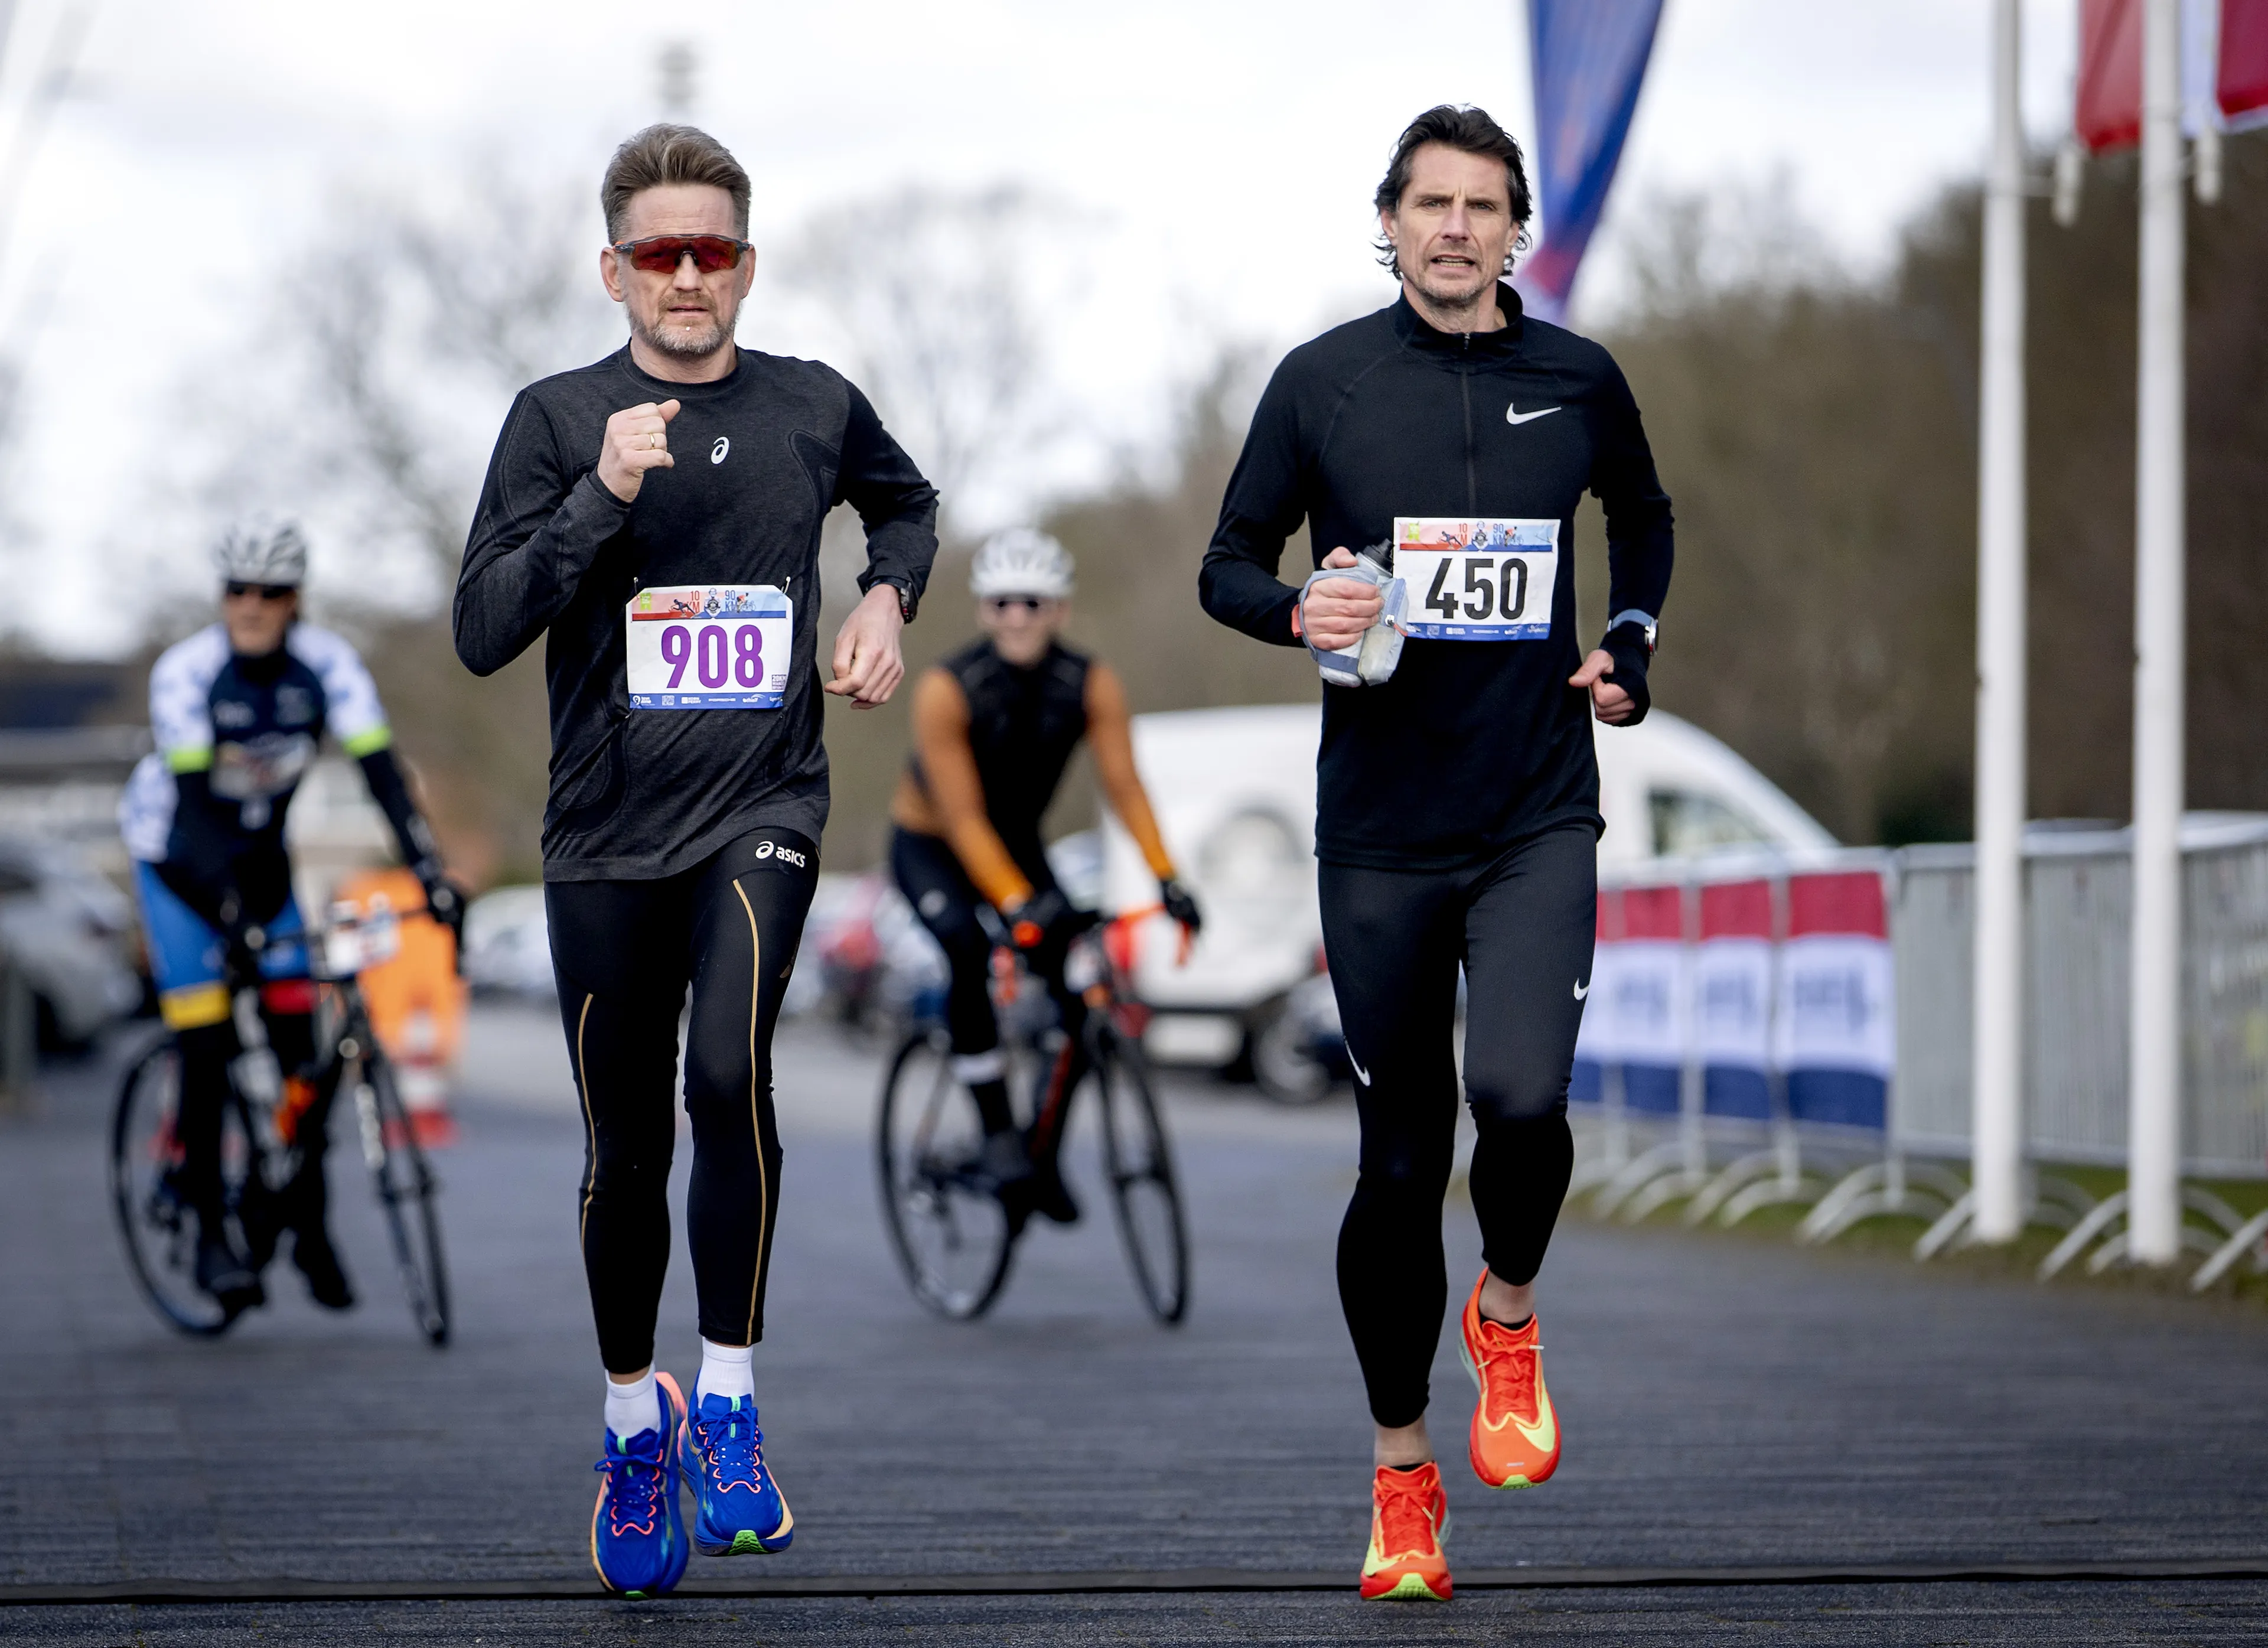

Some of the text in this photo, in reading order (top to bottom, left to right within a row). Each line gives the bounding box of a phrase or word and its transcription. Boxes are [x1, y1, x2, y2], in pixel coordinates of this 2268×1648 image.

[1458, 523, 1468, 533] 10
[1493, 523, 1504, 533] 90
[1426, 558, 1528, 620] 450
[690, 590, 700, 601] 10
[725, 590, 736, 600] 90
[661, 624, 764, 689] 908
[775, 845, 806, 868] asics
